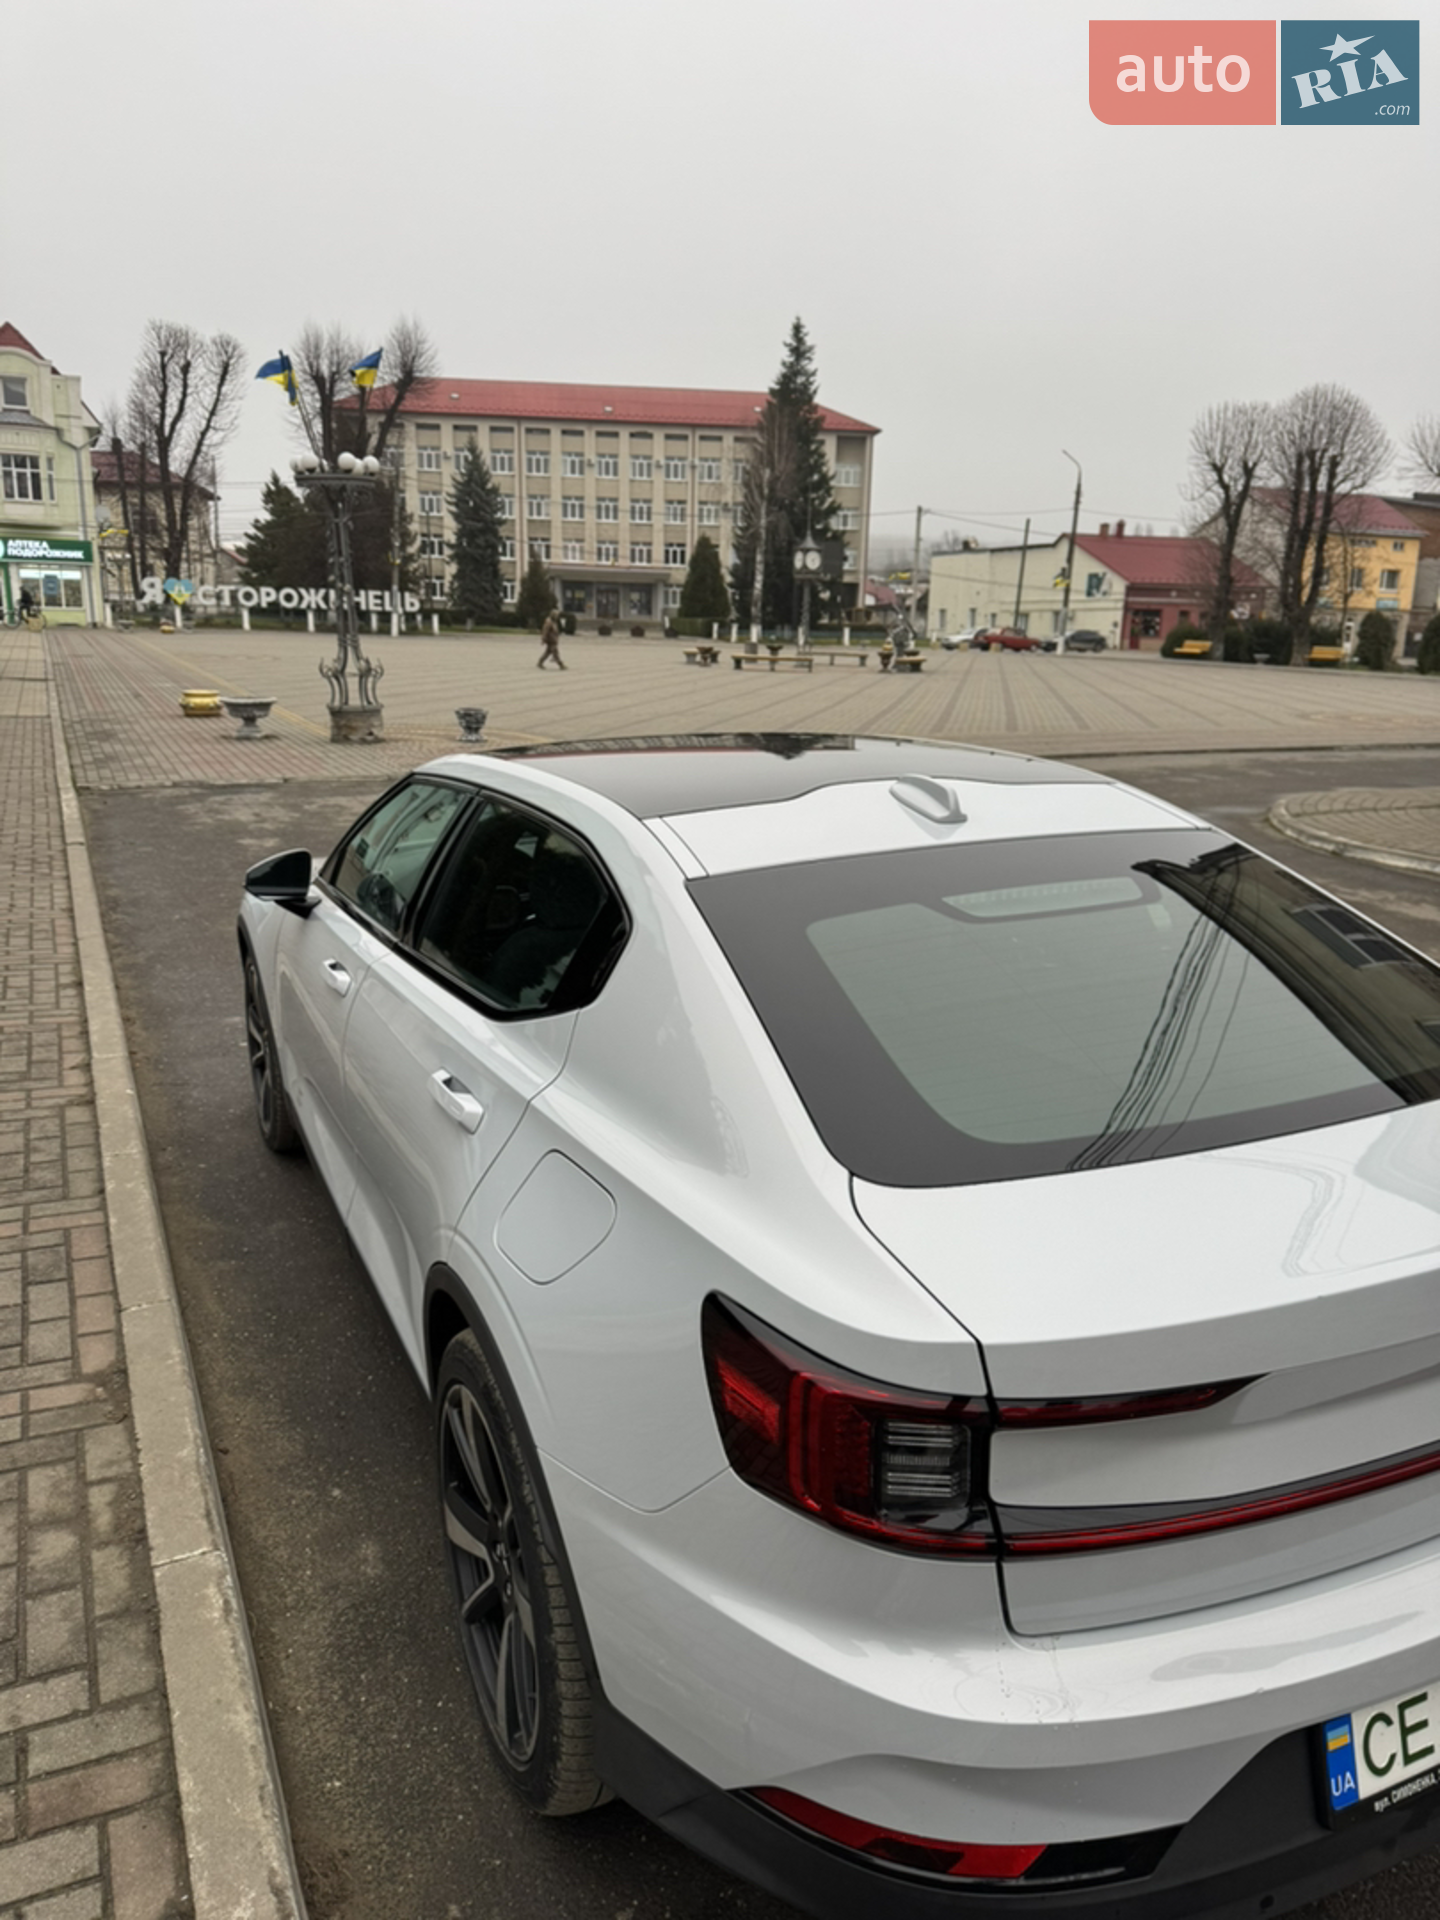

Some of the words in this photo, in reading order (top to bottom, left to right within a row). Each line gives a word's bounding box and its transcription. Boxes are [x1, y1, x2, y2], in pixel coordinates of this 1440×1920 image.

[7, 539, 50, 550] АПТЕКА
[140, 576, 165, 605] Я
[1363, 1691, 1435, 1778] CE
[1330, 1770, 1356, 1797] UA
